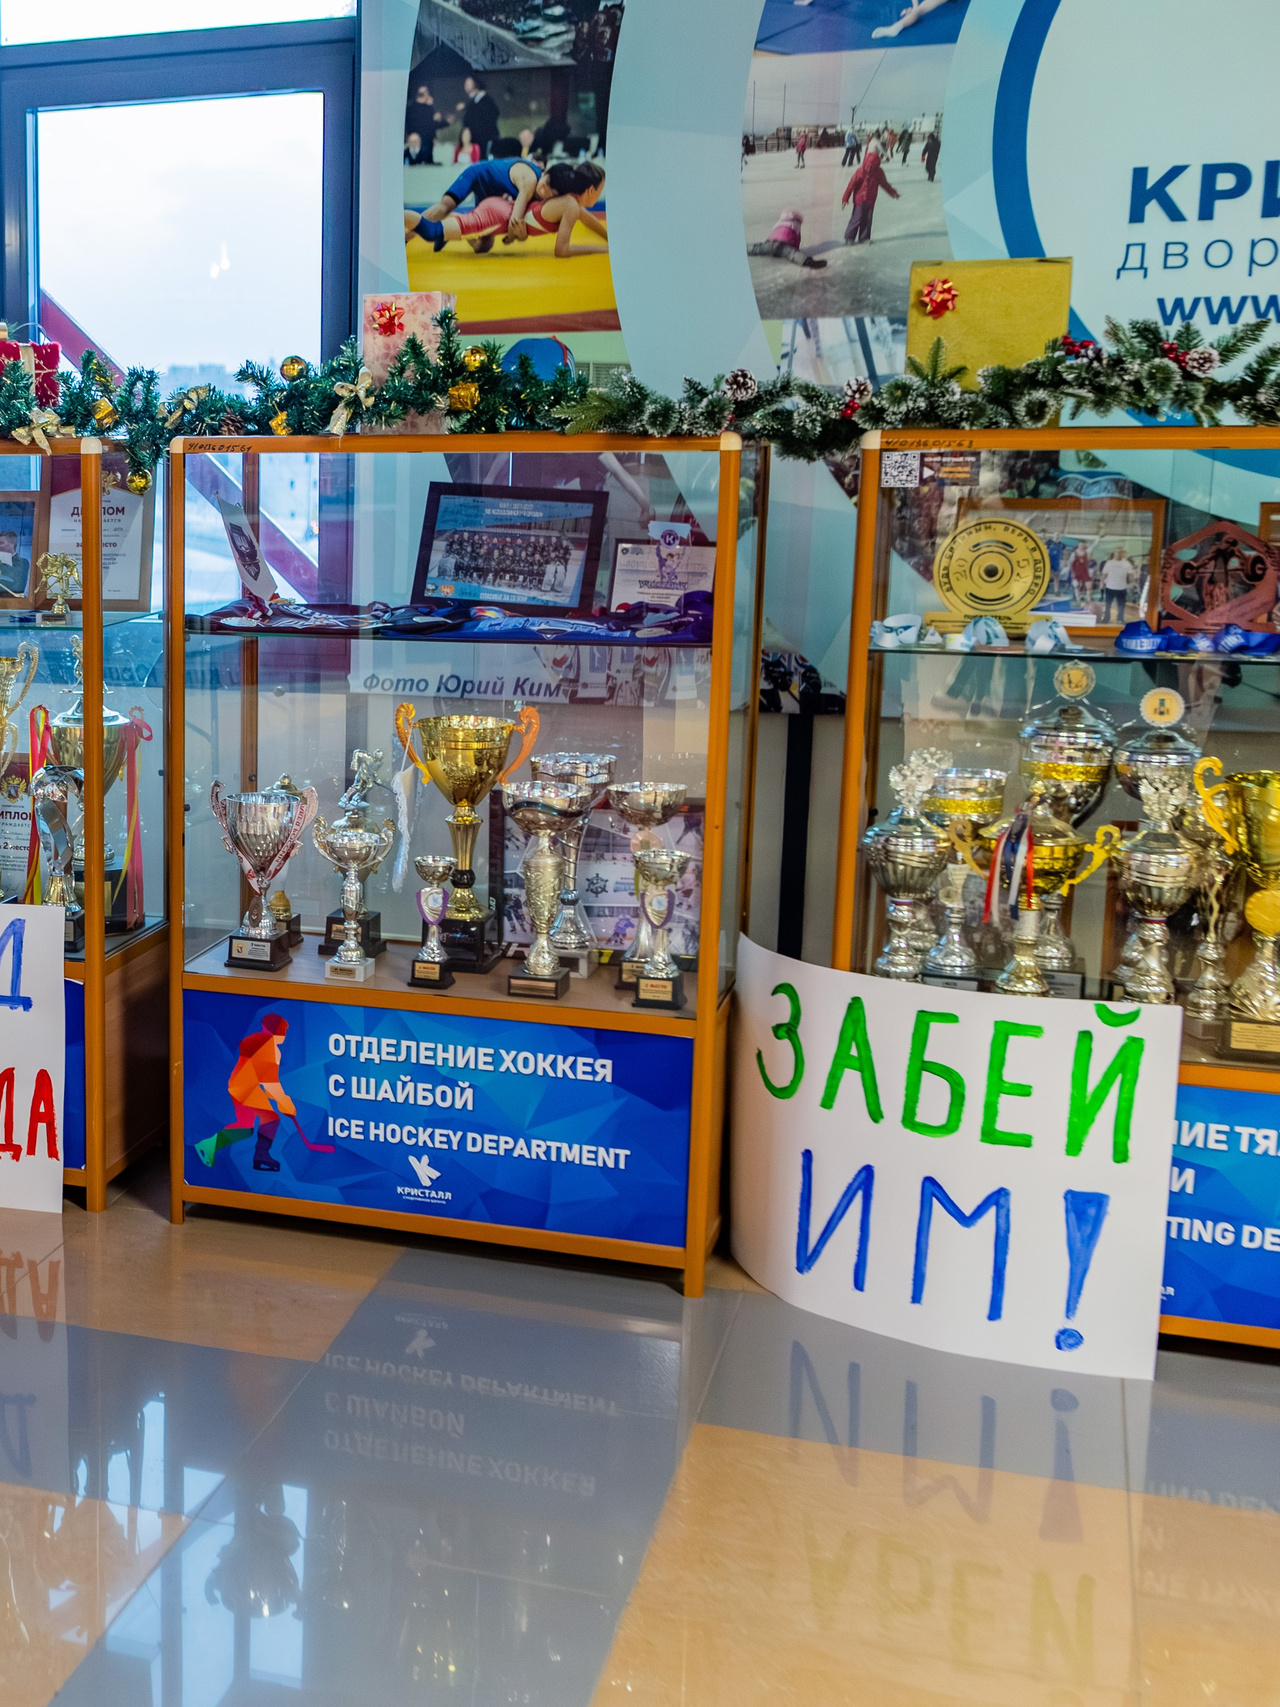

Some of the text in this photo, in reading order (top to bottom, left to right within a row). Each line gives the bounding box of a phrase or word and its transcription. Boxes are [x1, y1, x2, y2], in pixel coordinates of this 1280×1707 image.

[71, 506, 126, 517] ДЛОМ
[363, 673, 562, 699] Фото Юрий Ким
[328, 1033, 613, 1083] ОТДЕЛЕНИЕ ХОККЕЯ
[757, 982, 1144, 1164] ЗАБЕЙ
[329, 1074, 475, 1111] С ШАЙБОЙ
[328, 1117, 631, 1170] ICE HOCKEY DEPARTMENT
[1234, 1126, 1280, 1157] ТЯ
[396, 1186, 452, 1200] КРИСТАЛЛ
[796, 1149, 1110, 1351] ИМ!
